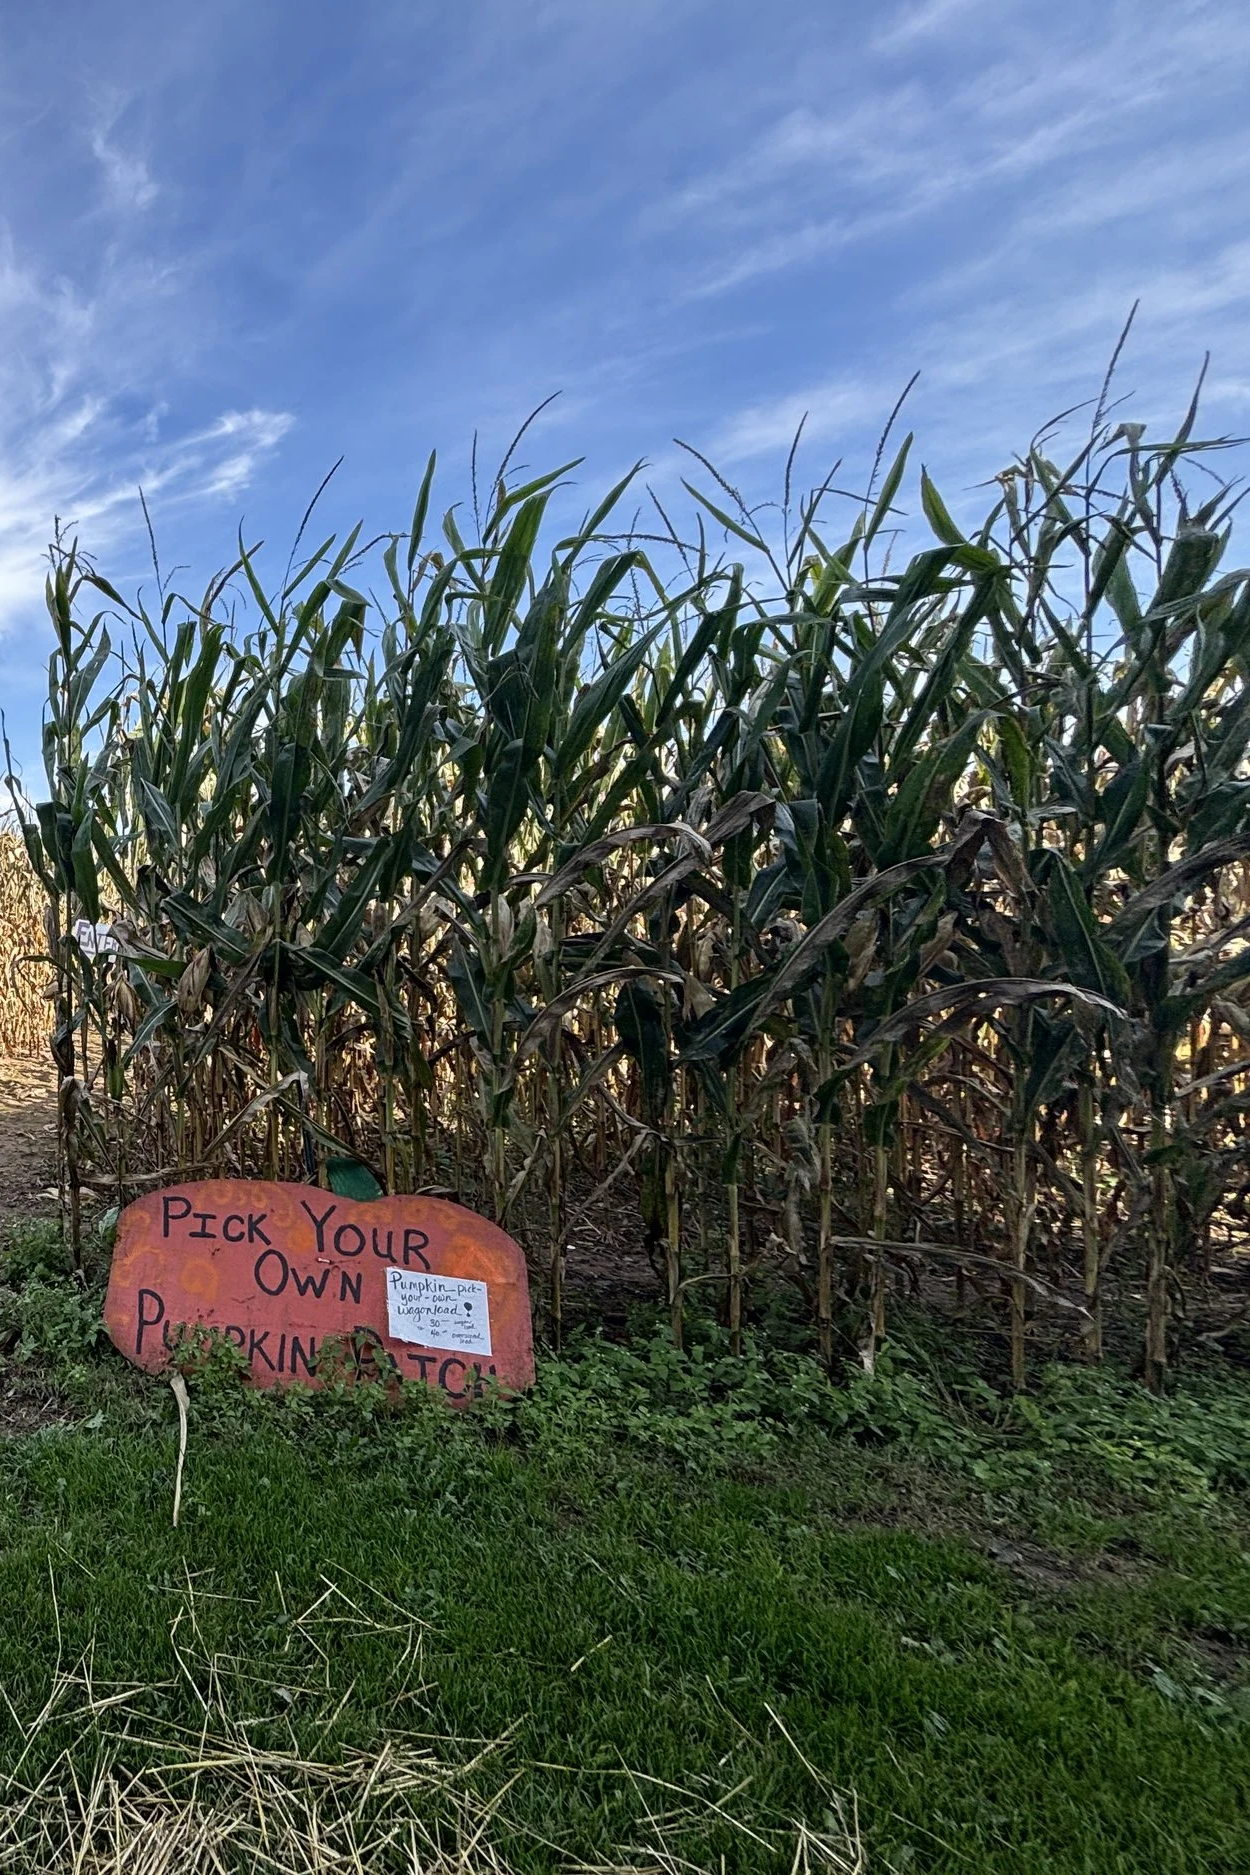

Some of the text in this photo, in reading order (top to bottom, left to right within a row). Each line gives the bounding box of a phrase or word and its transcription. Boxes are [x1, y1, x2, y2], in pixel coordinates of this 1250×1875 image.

[162, 1196, 430, 1270] PICK YOUR
[254, 1249, 363, 1304] OWN
[389, 1271, 483, 1296] Pumpkin pick-
[136, 1288, 317, 1378] PUPKIN
